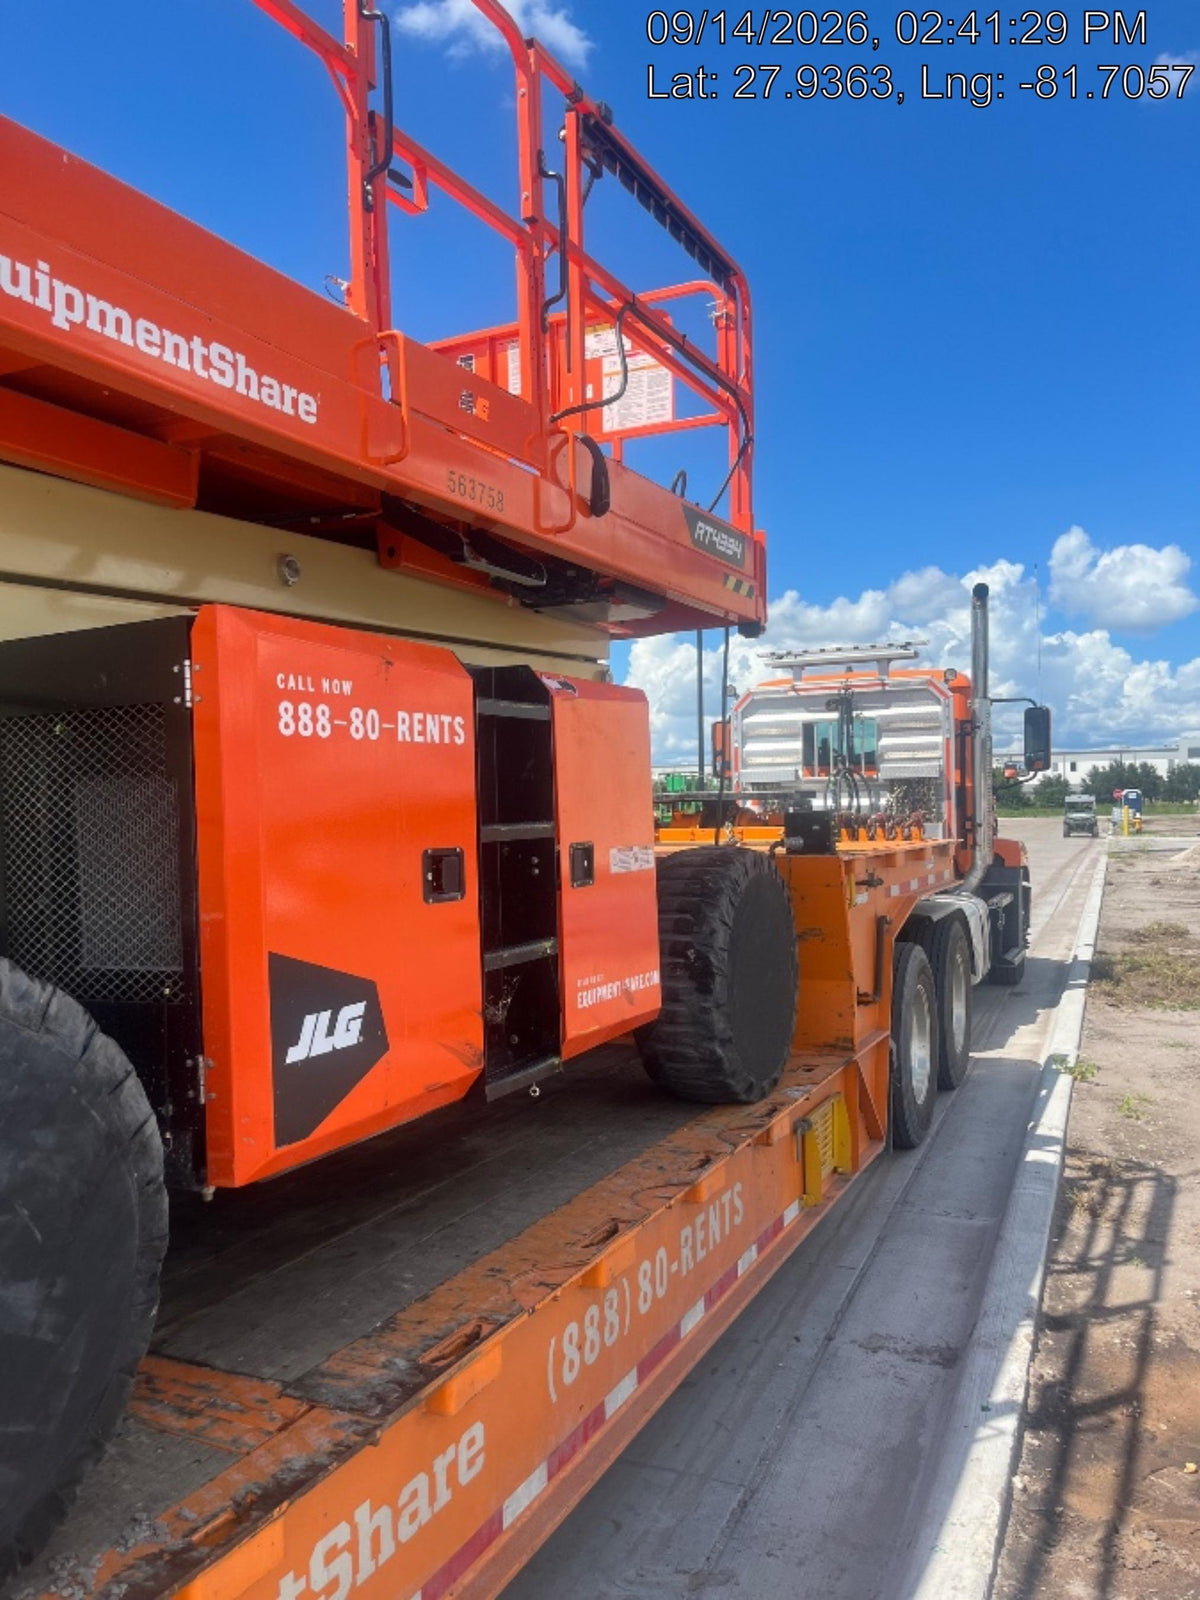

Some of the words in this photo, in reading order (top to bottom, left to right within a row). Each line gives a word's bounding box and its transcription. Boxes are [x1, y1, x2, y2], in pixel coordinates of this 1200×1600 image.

[0, 254, 318, 425] uipmentShare
[447, 469, 504, 514] 563758
[276, 672, 315, 692] CALL
[321, 677, 353, 696] NOW
[278, 700, 466, 746] 888-80-RENTS
[576, 969, 660, 1010] EQUIPMENTARE.COM
[285, 1000, 367, 1065] JLG
